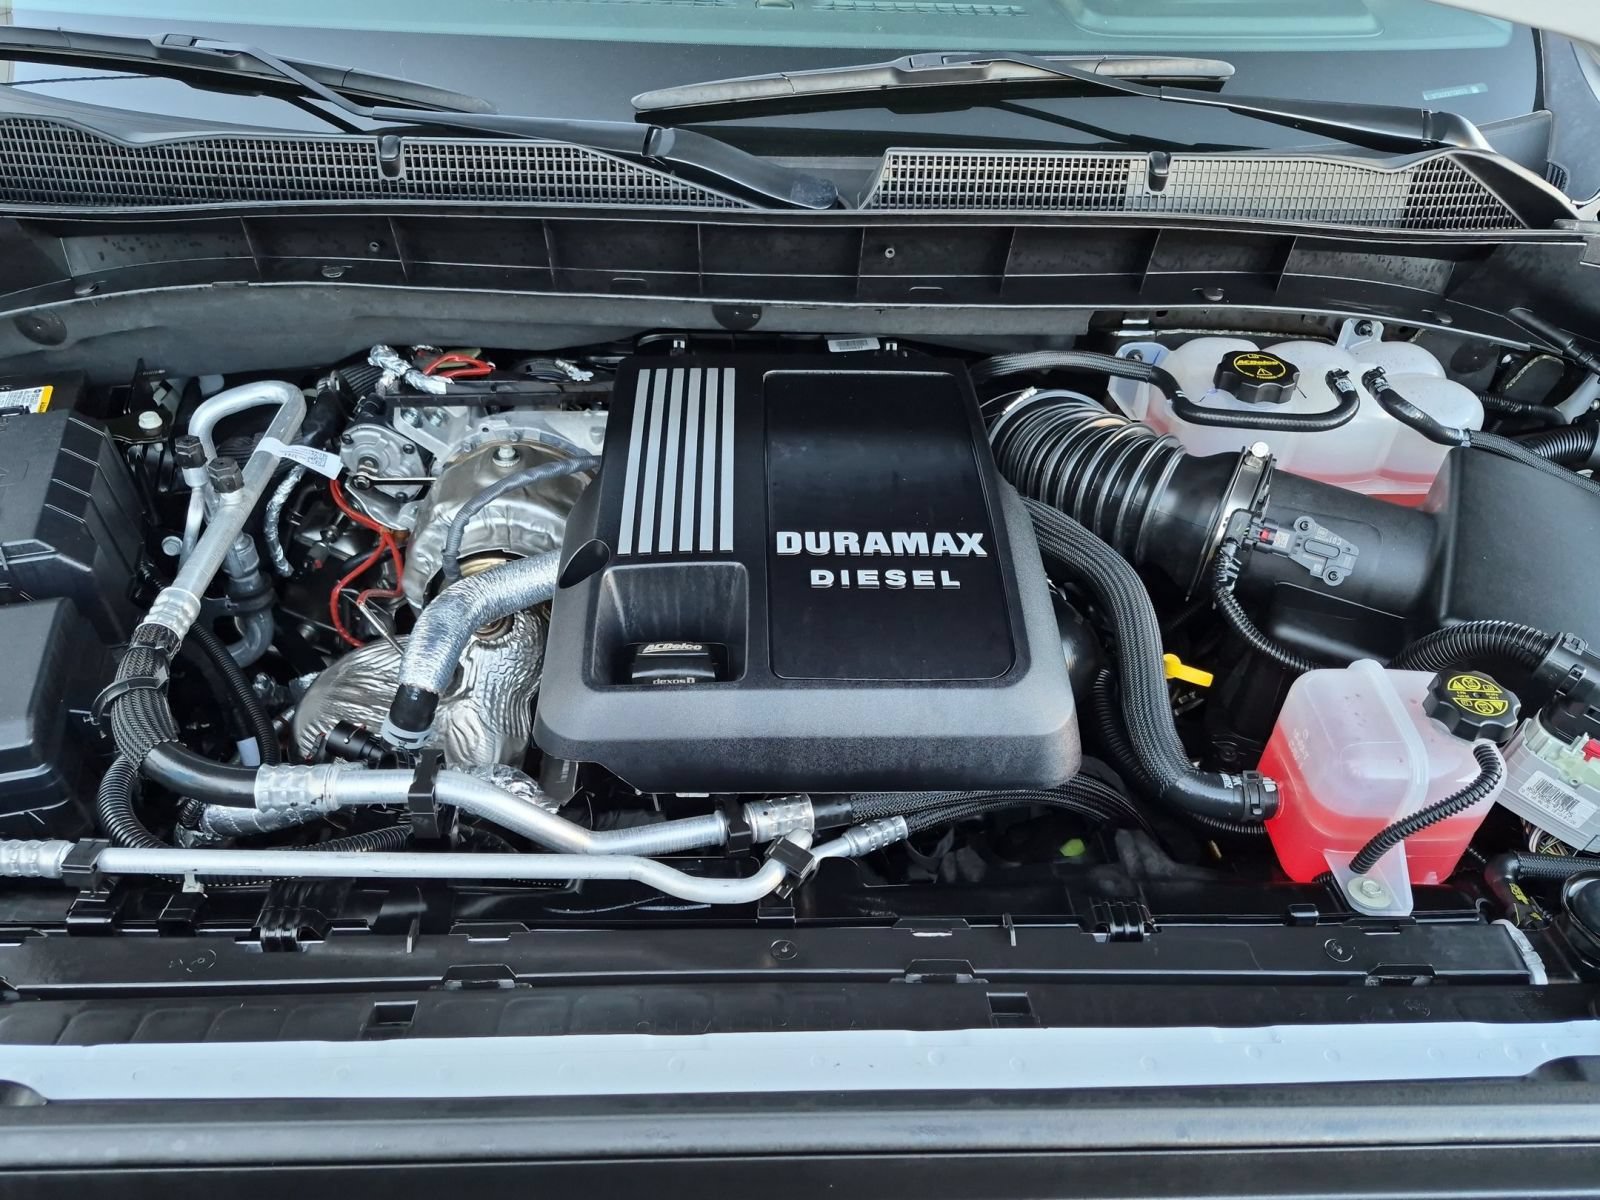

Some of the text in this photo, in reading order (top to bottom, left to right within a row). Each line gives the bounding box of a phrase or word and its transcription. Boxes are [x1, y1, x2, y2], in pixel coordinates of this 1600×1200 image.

[776, 531, 988, 557] DURAMAX
[810, 569, 961, 590] DIESEL
[642, 642, 703, 654] ACDelco
